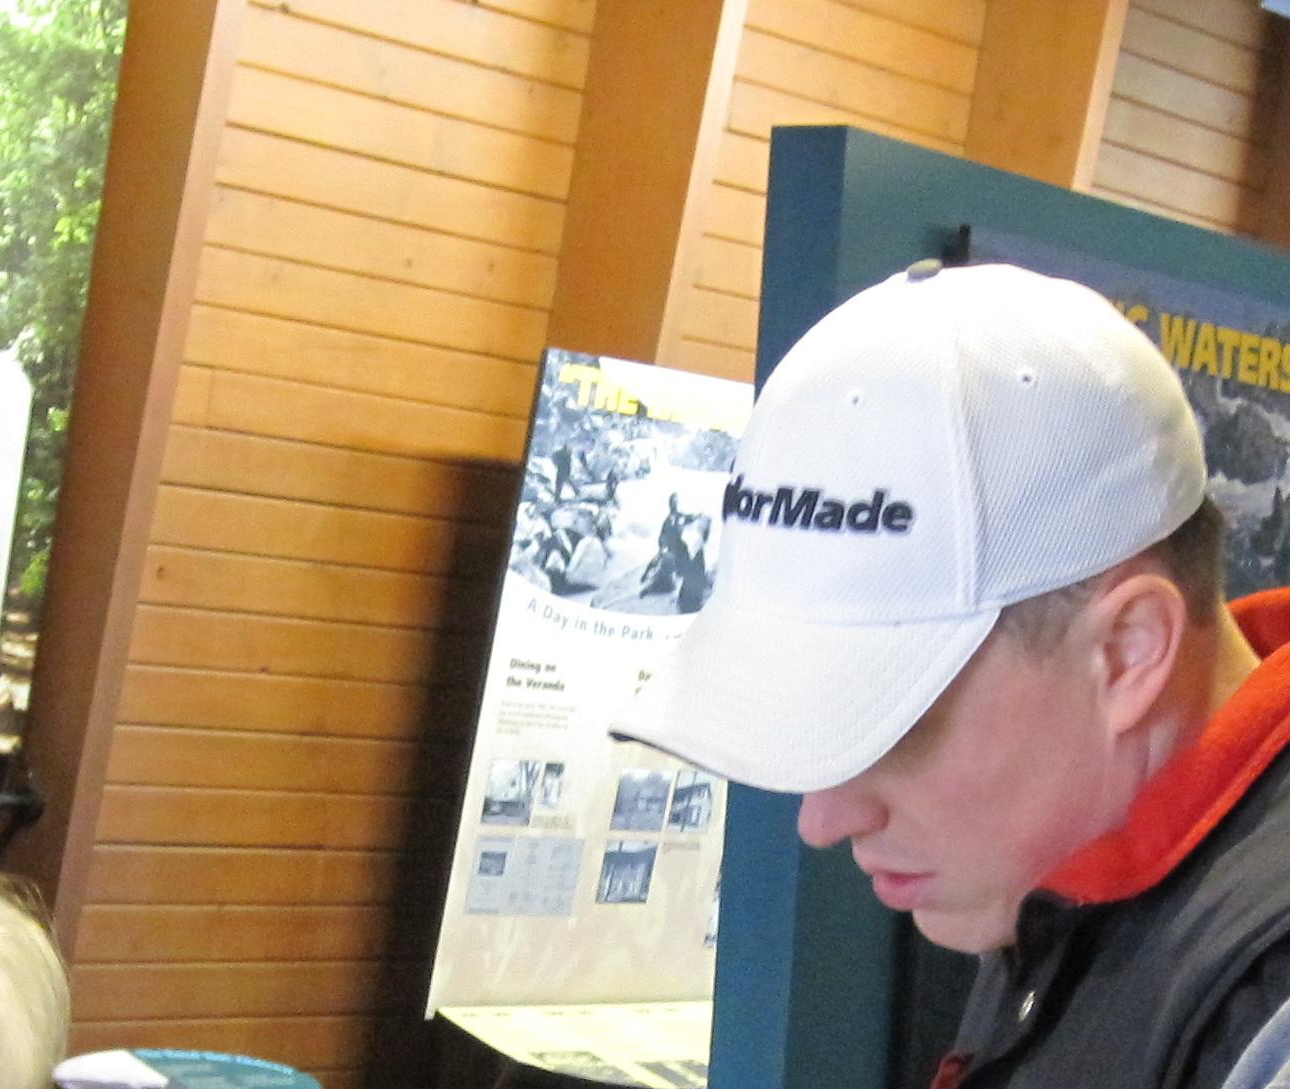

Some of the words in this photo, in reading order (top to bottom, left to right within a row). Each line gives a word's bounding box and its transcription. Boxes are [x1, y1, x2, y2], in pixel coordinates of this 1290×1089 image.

[543, 605, 568, 630] Day
[574, 616, 588, 632] in
[593, 620, 615, 638] the
[621, 624, 654, 641] Park
[509, 657, 542, 674] Dining
[545, 663, 557, 673] on
[506, 675, 522, 688] the
[526, 678, 566, 692] Veranda
